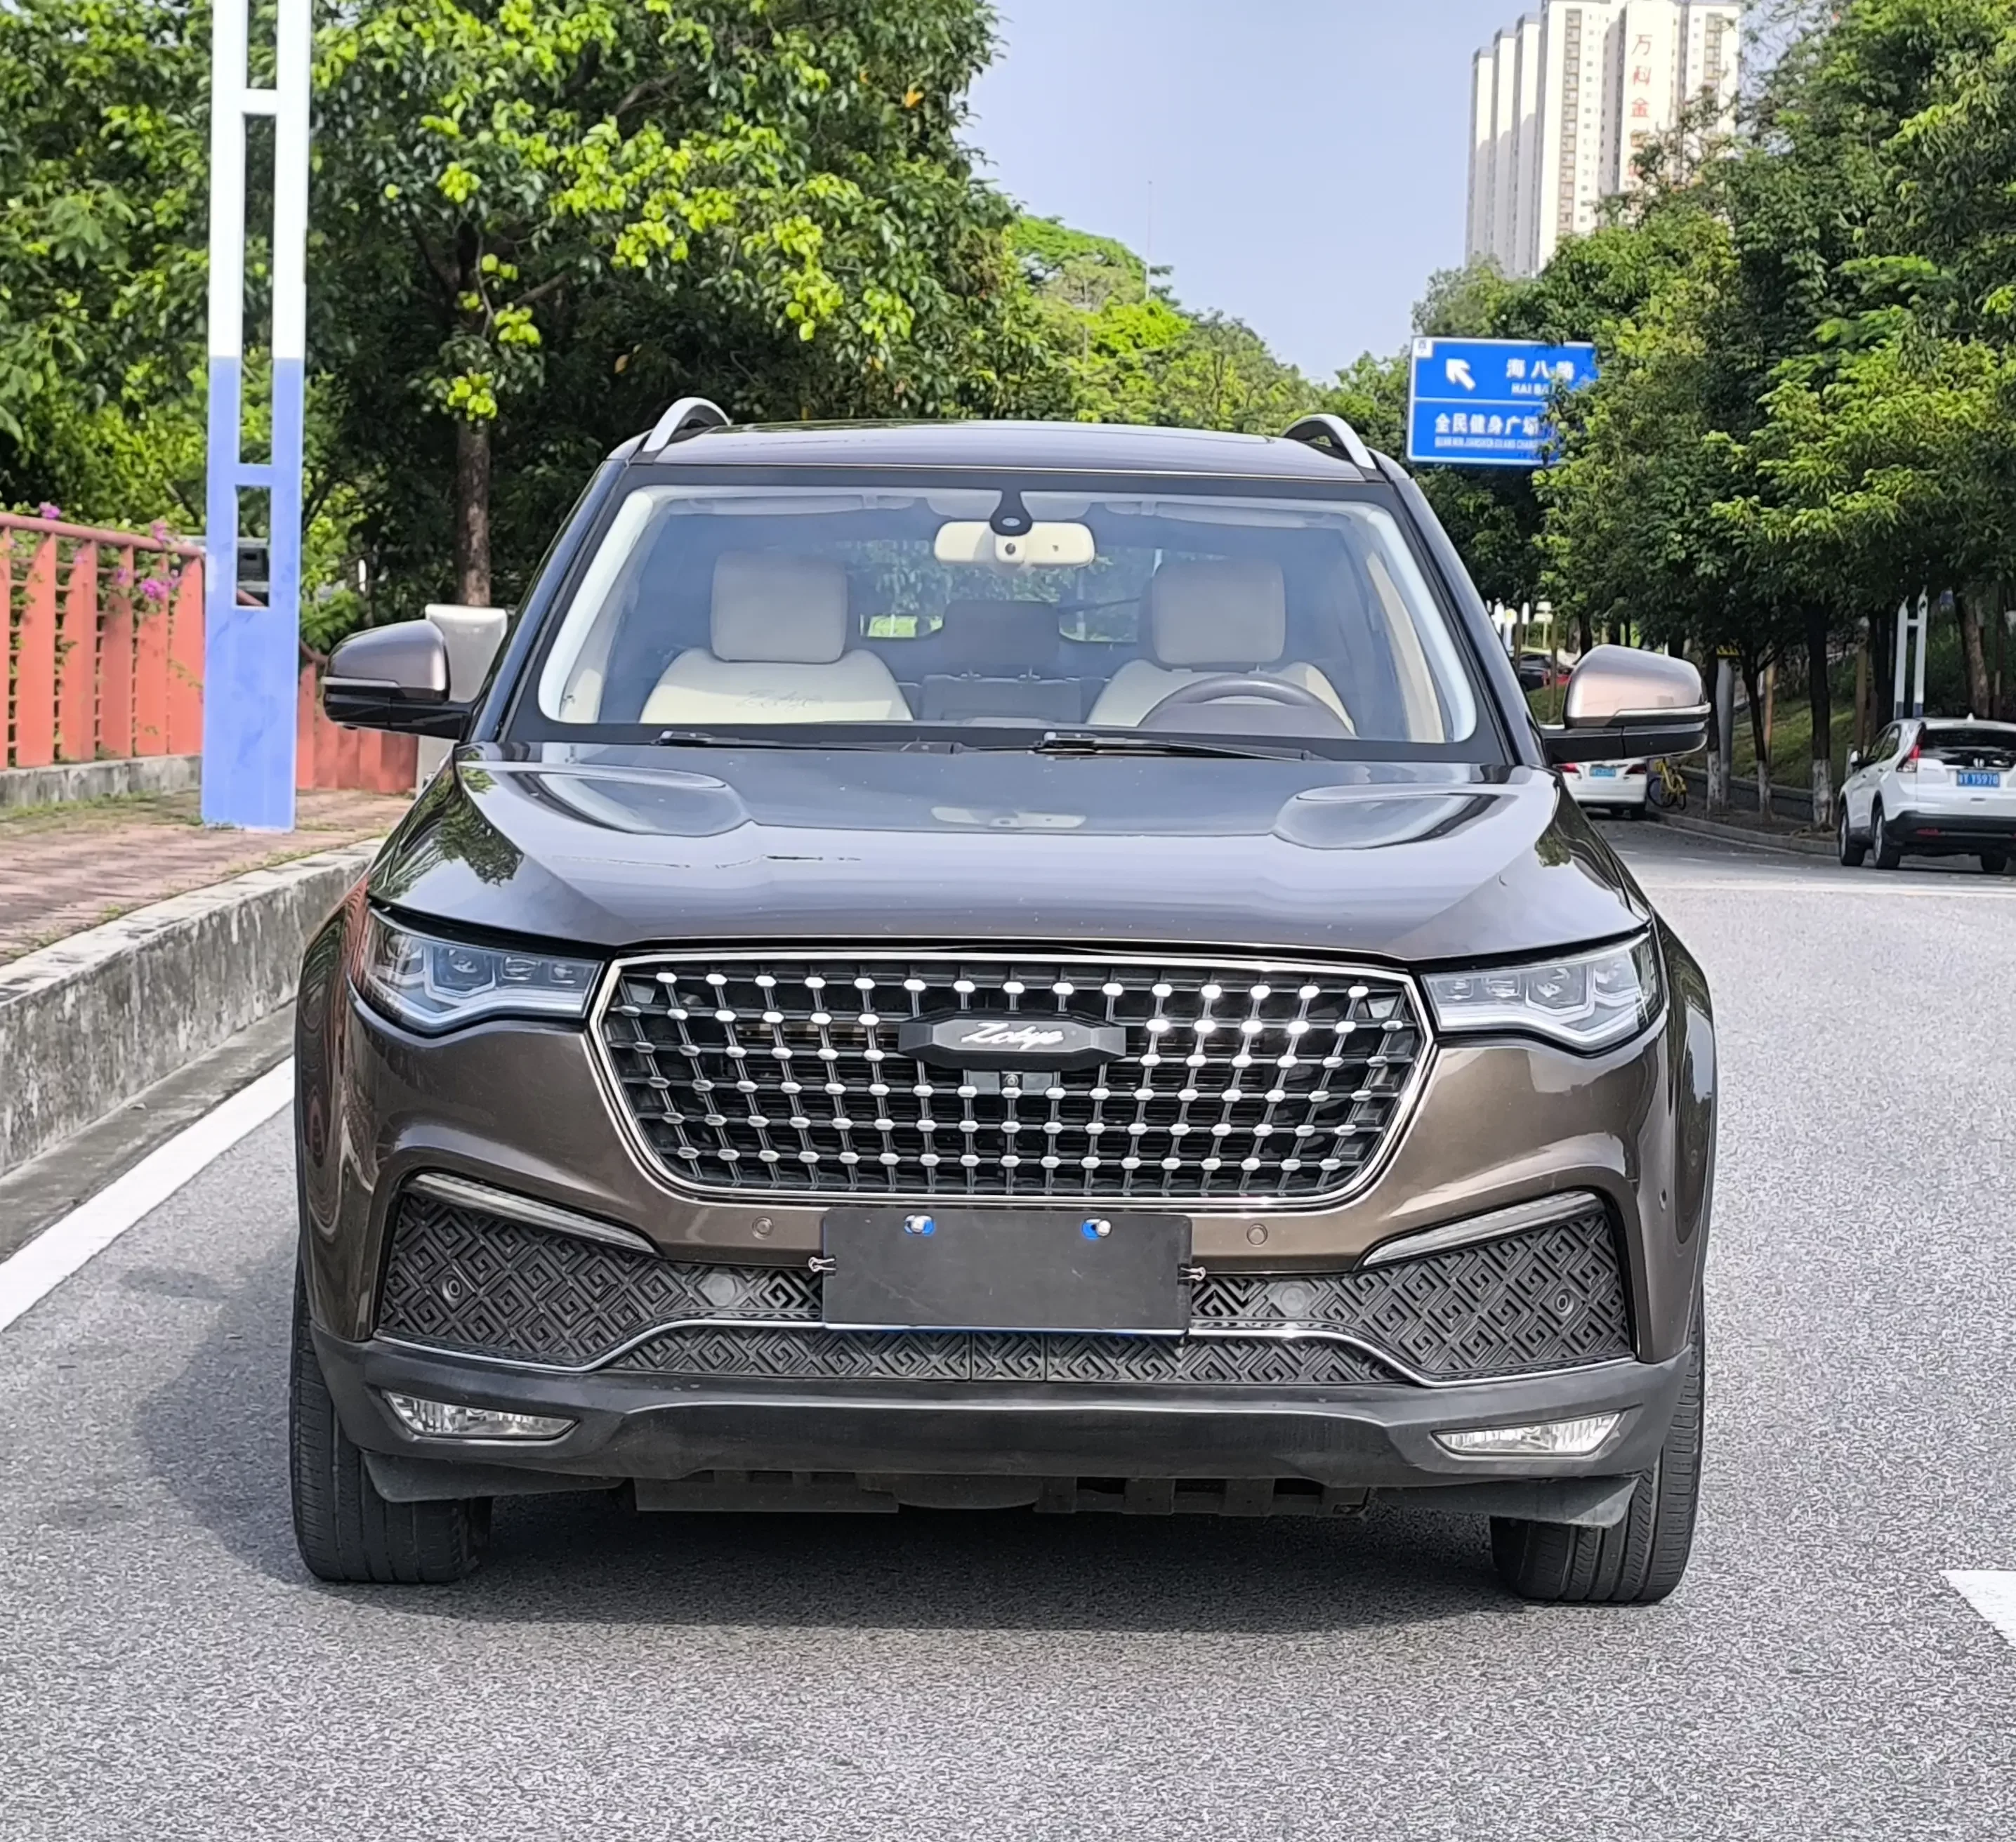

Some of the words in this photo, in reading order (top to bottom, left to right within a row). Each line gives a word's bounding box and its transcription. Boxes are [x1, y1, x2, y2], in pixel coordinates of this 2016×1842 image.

[1511, 382, 1532, 395] HAI
[1435, 412, 1539, 436] 全民健身广场
